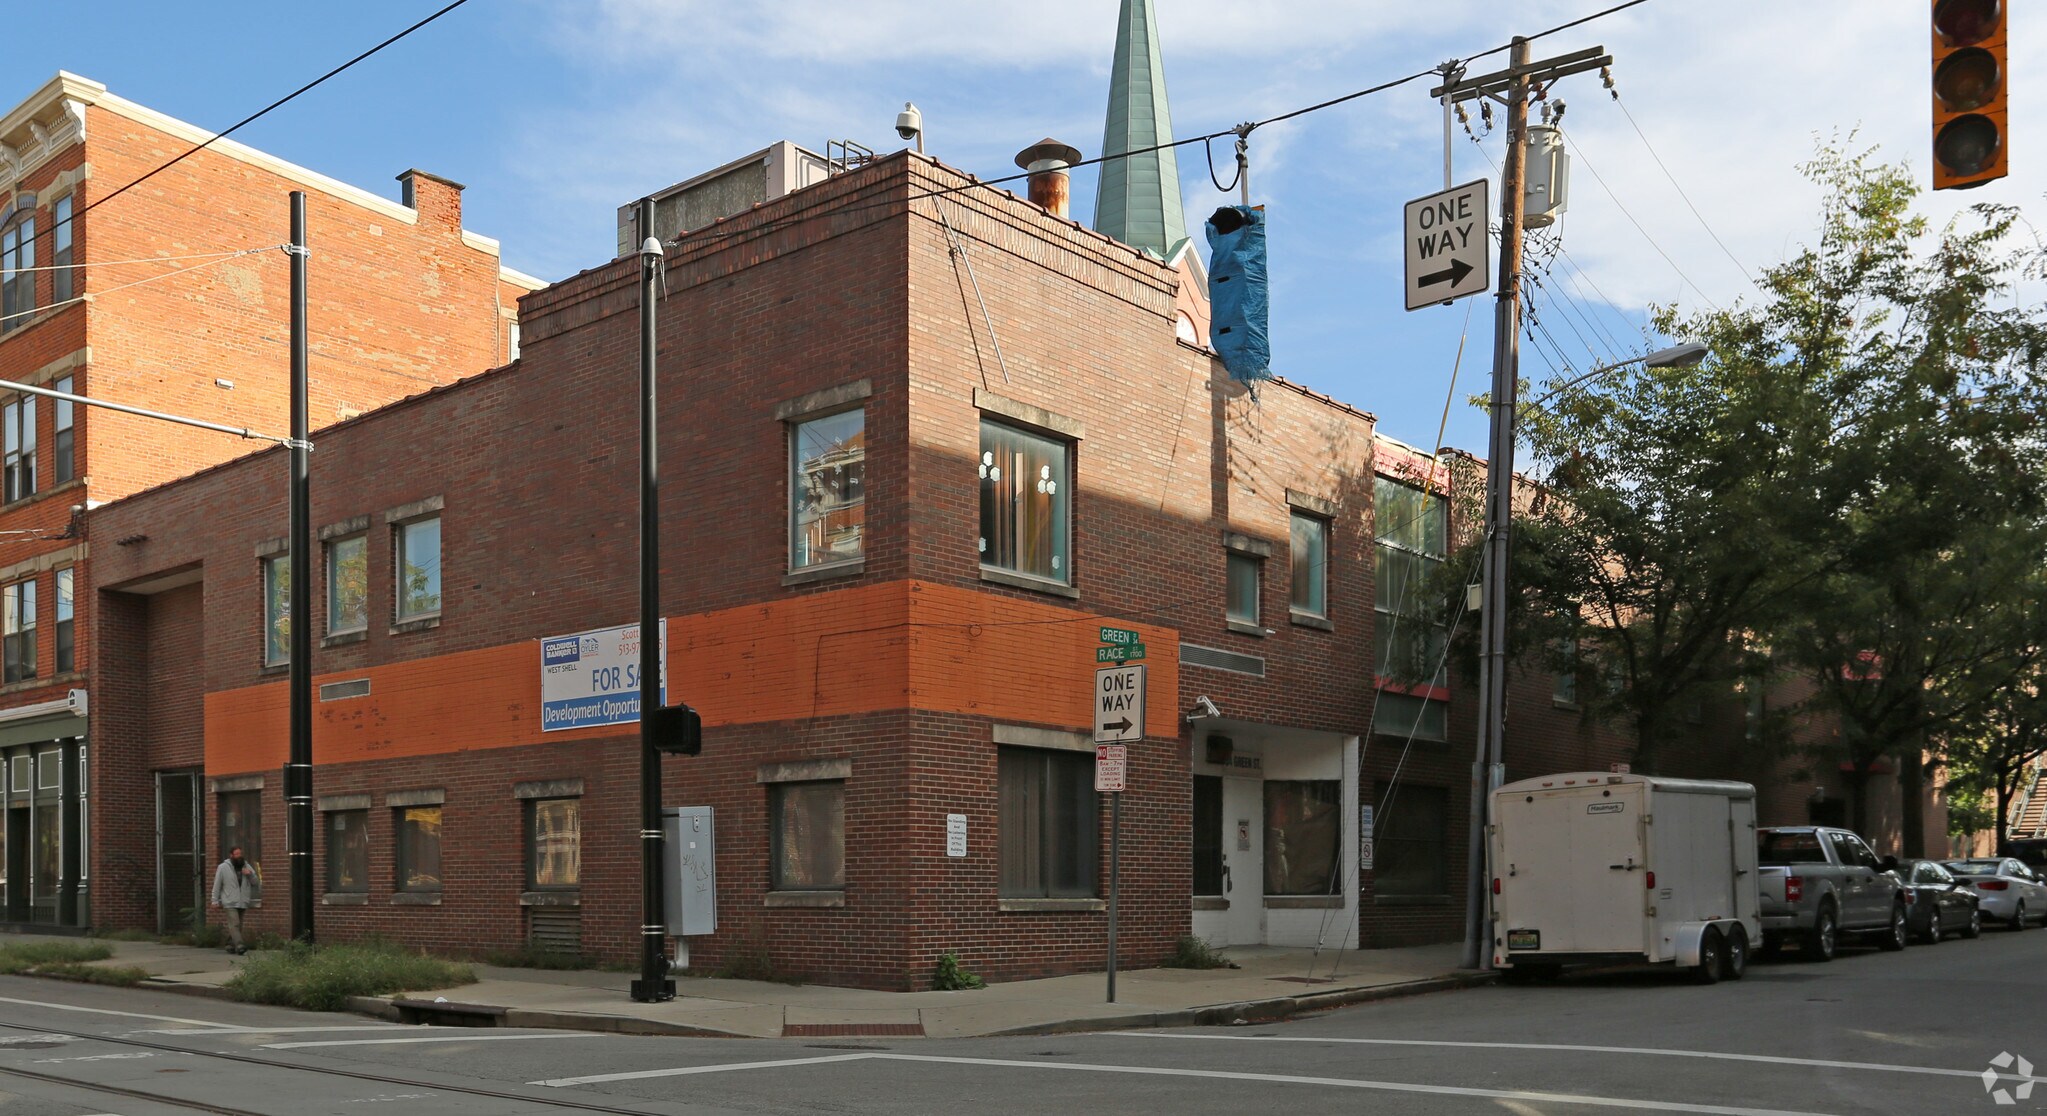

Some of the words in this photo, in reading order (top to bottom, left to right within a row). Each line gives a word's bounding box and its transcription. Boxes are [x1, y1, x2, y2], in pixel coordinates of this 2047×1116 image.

[1419, 193, 1473, 230] ONE
[1417, 222, 1474, 260] WAY
[622, 627, 639, 640] Scott
[1101, 629, 1130, 643] GREEN
[546, 641, 577, 651] COLDWELL
[546, 647, 571, 658] BANKER
[1099, 647, 1125, 660] RACE
[547, 665, 561, 673] WEST
[562, 664, 577, 672] SHELL
[592, 666, 621, 692] FOR
[1103, 673, 1135, 692] ONE
[1102, 693, 1135, 712] WAY
[545, 701, 601, 725] Development
[602, 697, 641, 720] Opportu
